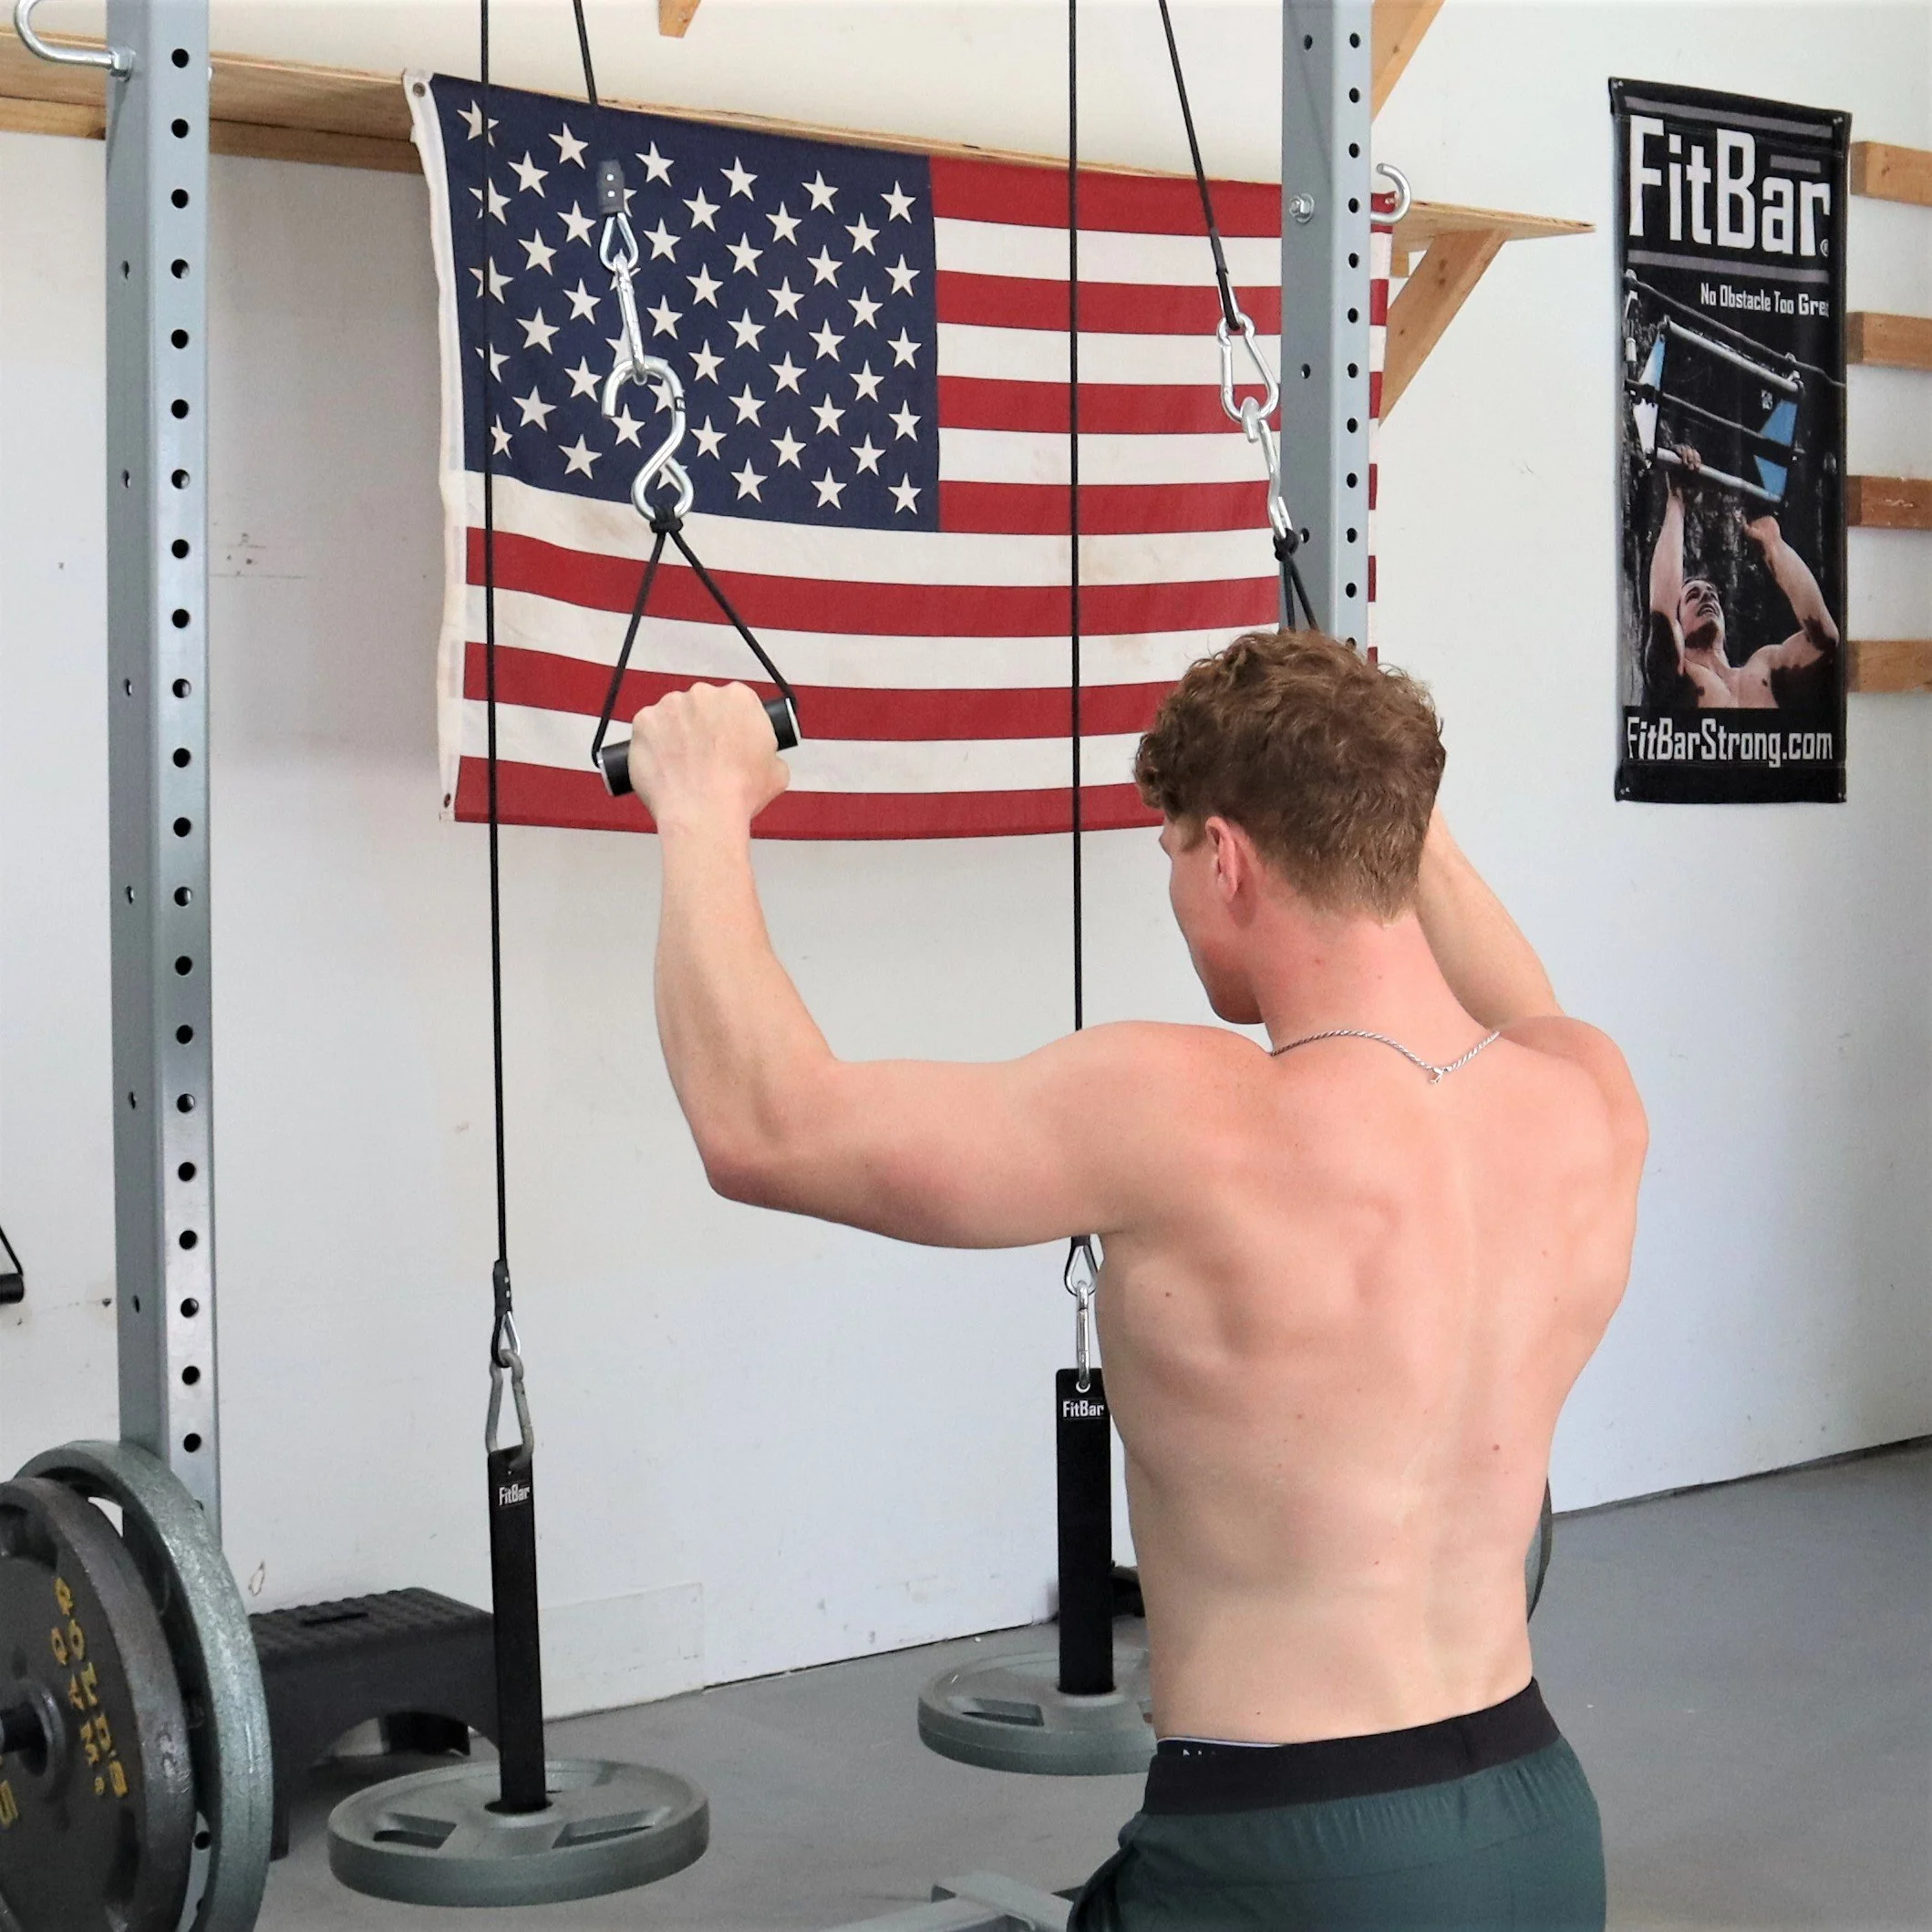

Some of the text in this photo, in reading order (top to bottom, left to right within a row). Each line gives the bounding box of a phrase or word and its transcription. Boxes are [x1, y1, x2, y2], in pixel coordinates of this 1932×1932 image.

[1628, 115, 1831, 256] FitBar
[1700, 283, 1830, 317] No Obstacle Too Gre
[1627, 716, 1833, 768] FitBarStrong.com
[1062, 1400, 1104, 1418] FitBar
[499, 1483, 530, 1506] FitBar
